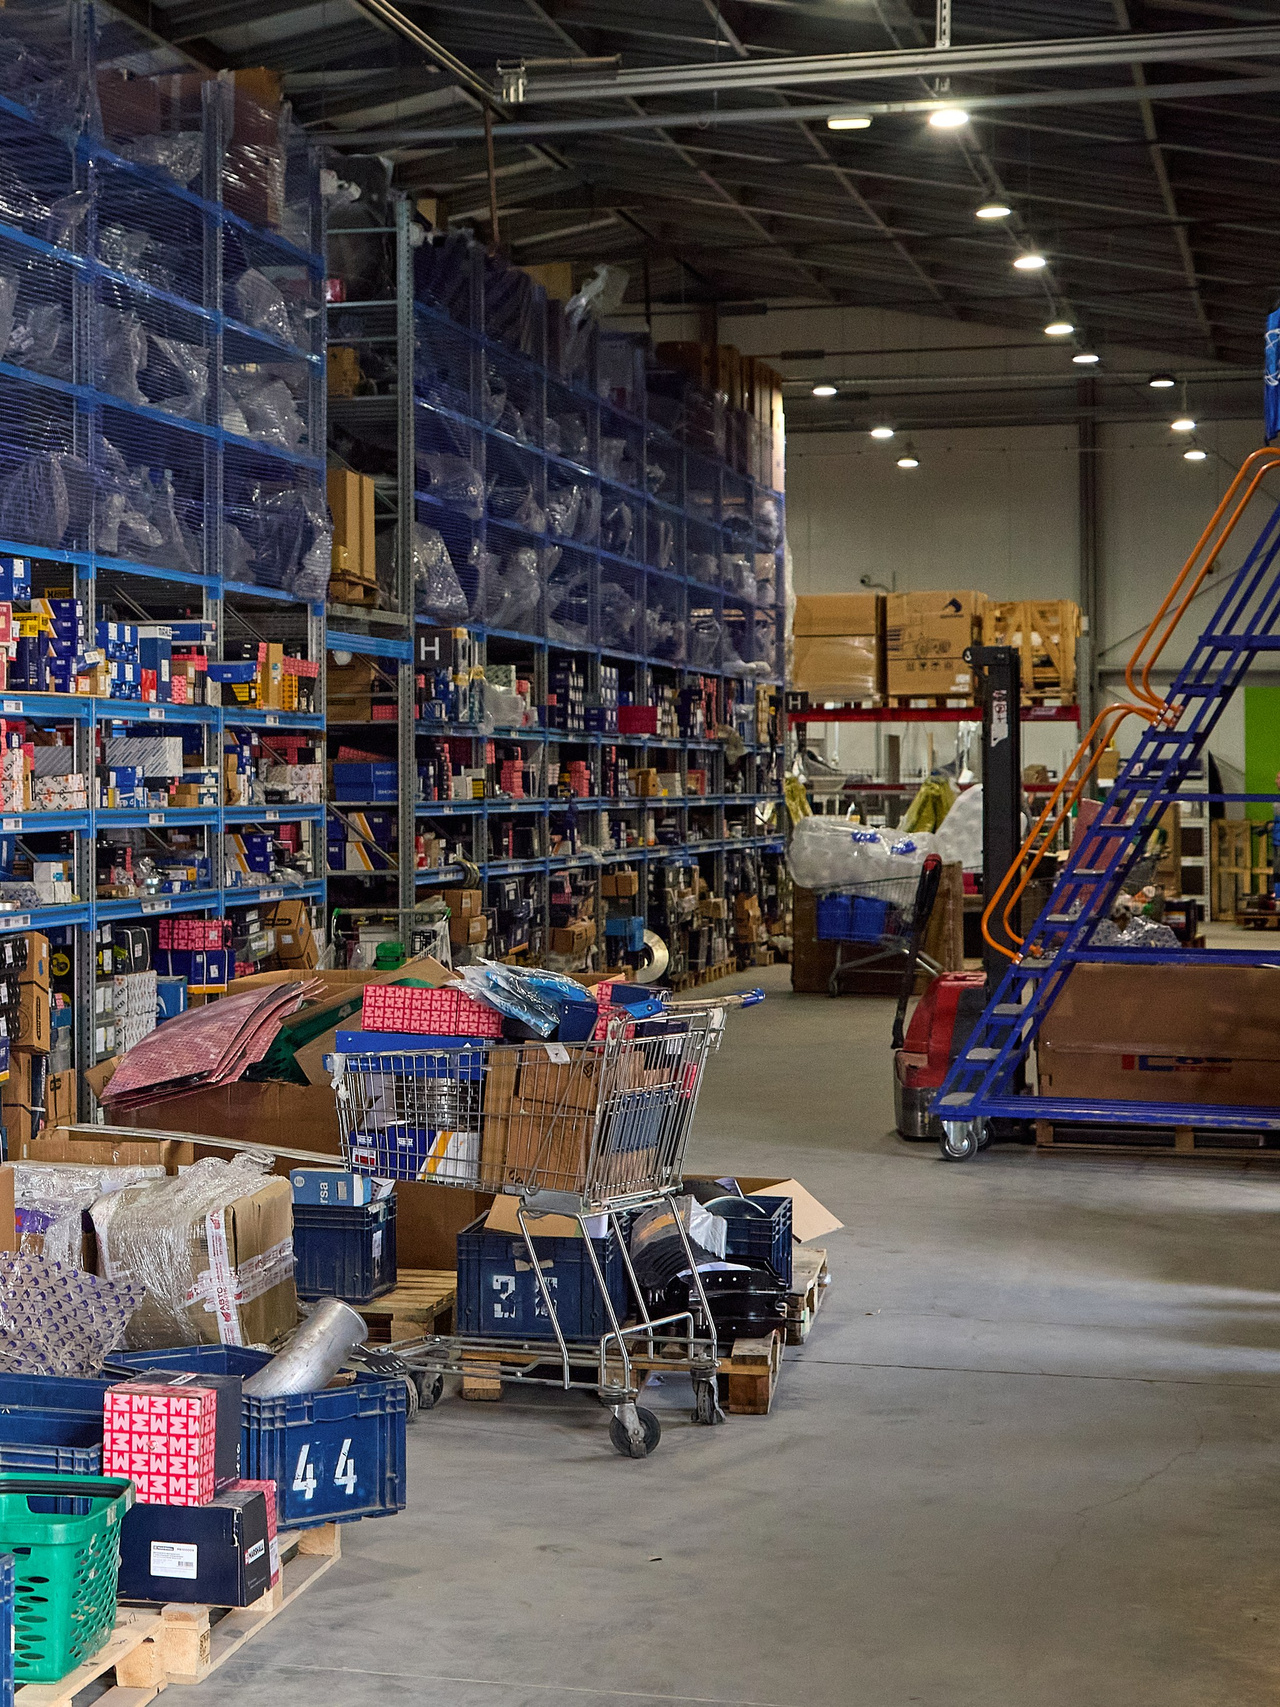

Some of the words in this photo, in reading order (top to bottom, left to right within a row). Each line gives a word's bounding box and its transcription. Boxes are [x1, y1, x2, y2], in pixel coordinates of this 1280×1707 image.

[421, 637, 440, 661] H
[789, 695, 801, 710] H
[216, 1286, 225, 1313] АВТО
